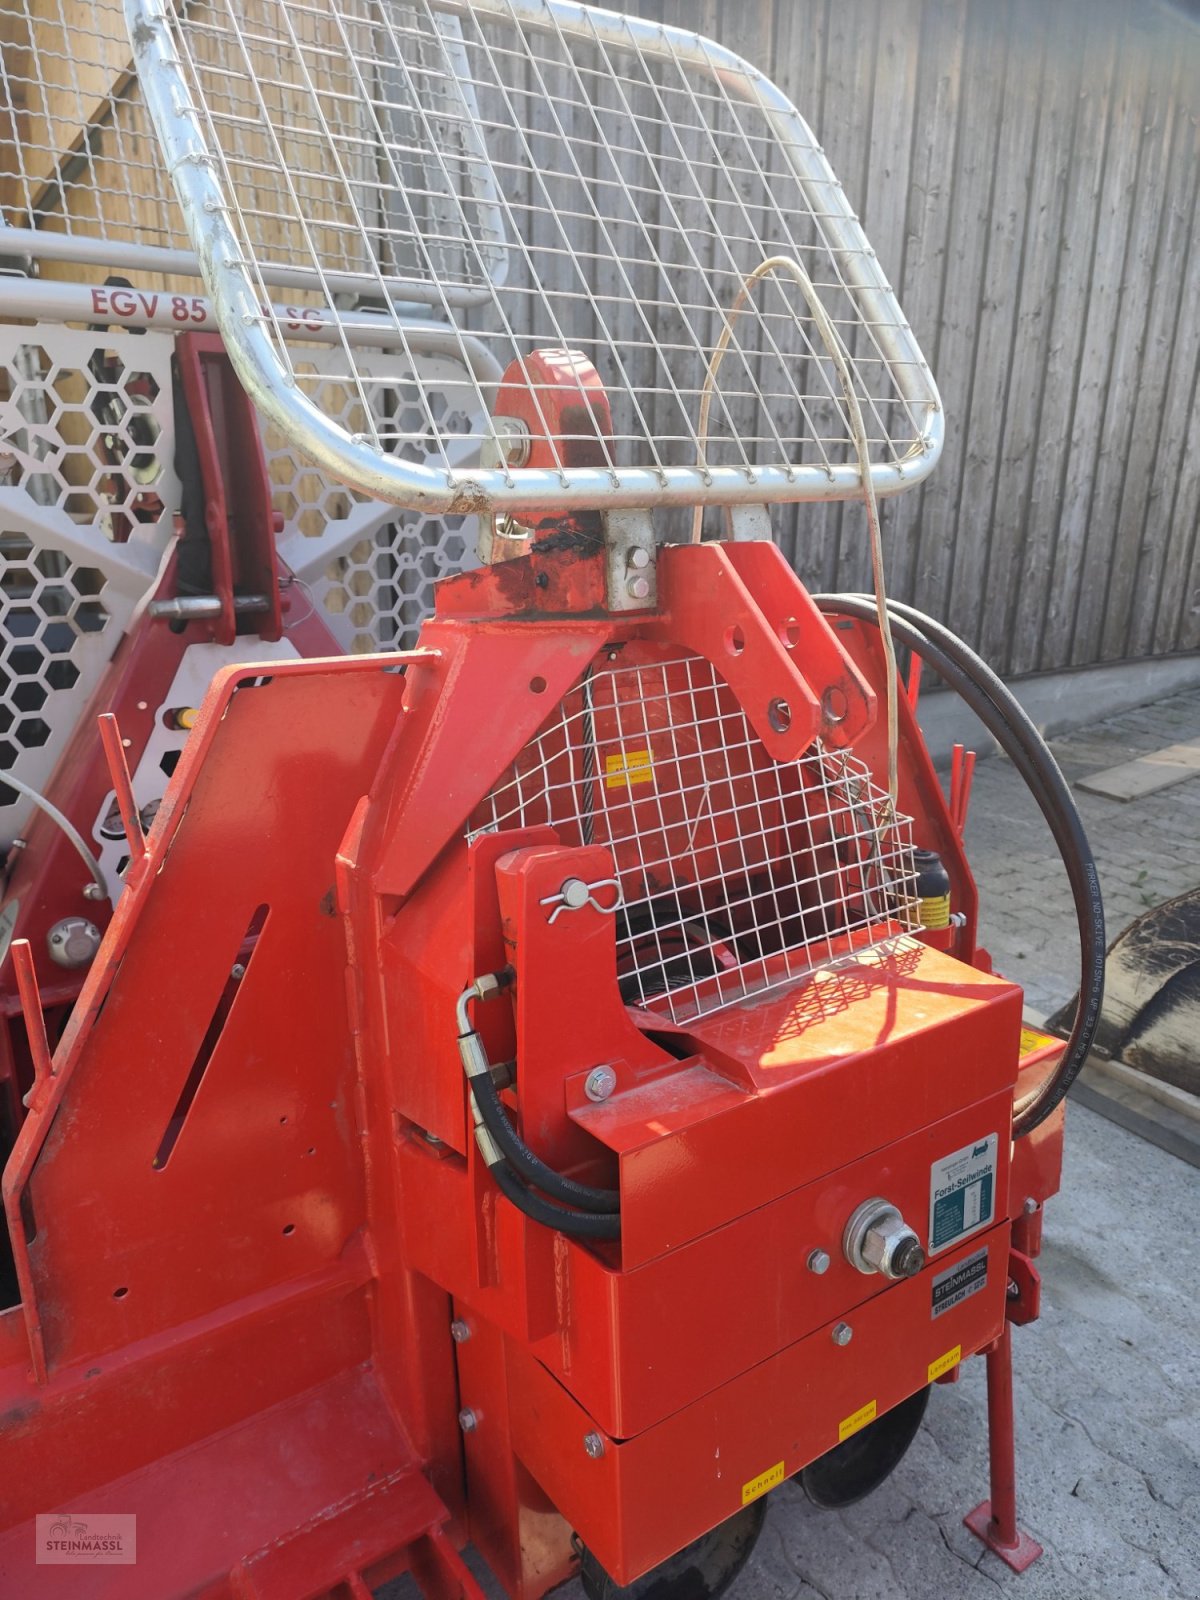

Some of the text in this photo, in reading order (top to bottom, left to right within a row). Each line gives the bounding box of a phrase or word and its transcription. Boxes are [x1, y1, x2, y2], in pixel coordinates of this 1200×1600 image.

[91, 288, 158, 319] EGV
[171, 296, 207, 323] 85
[286, 307, 324, 332] SG
[1085, 863, 1099, 897] PARKER
[1092, 901, 1103, 947] NO-SKIVE
[935, 1164, 992, 1199] Forst-Seilwinde
[929, 1351, 960, 1376] Langsam
[744, 1469, 782, 1496] Schnell
